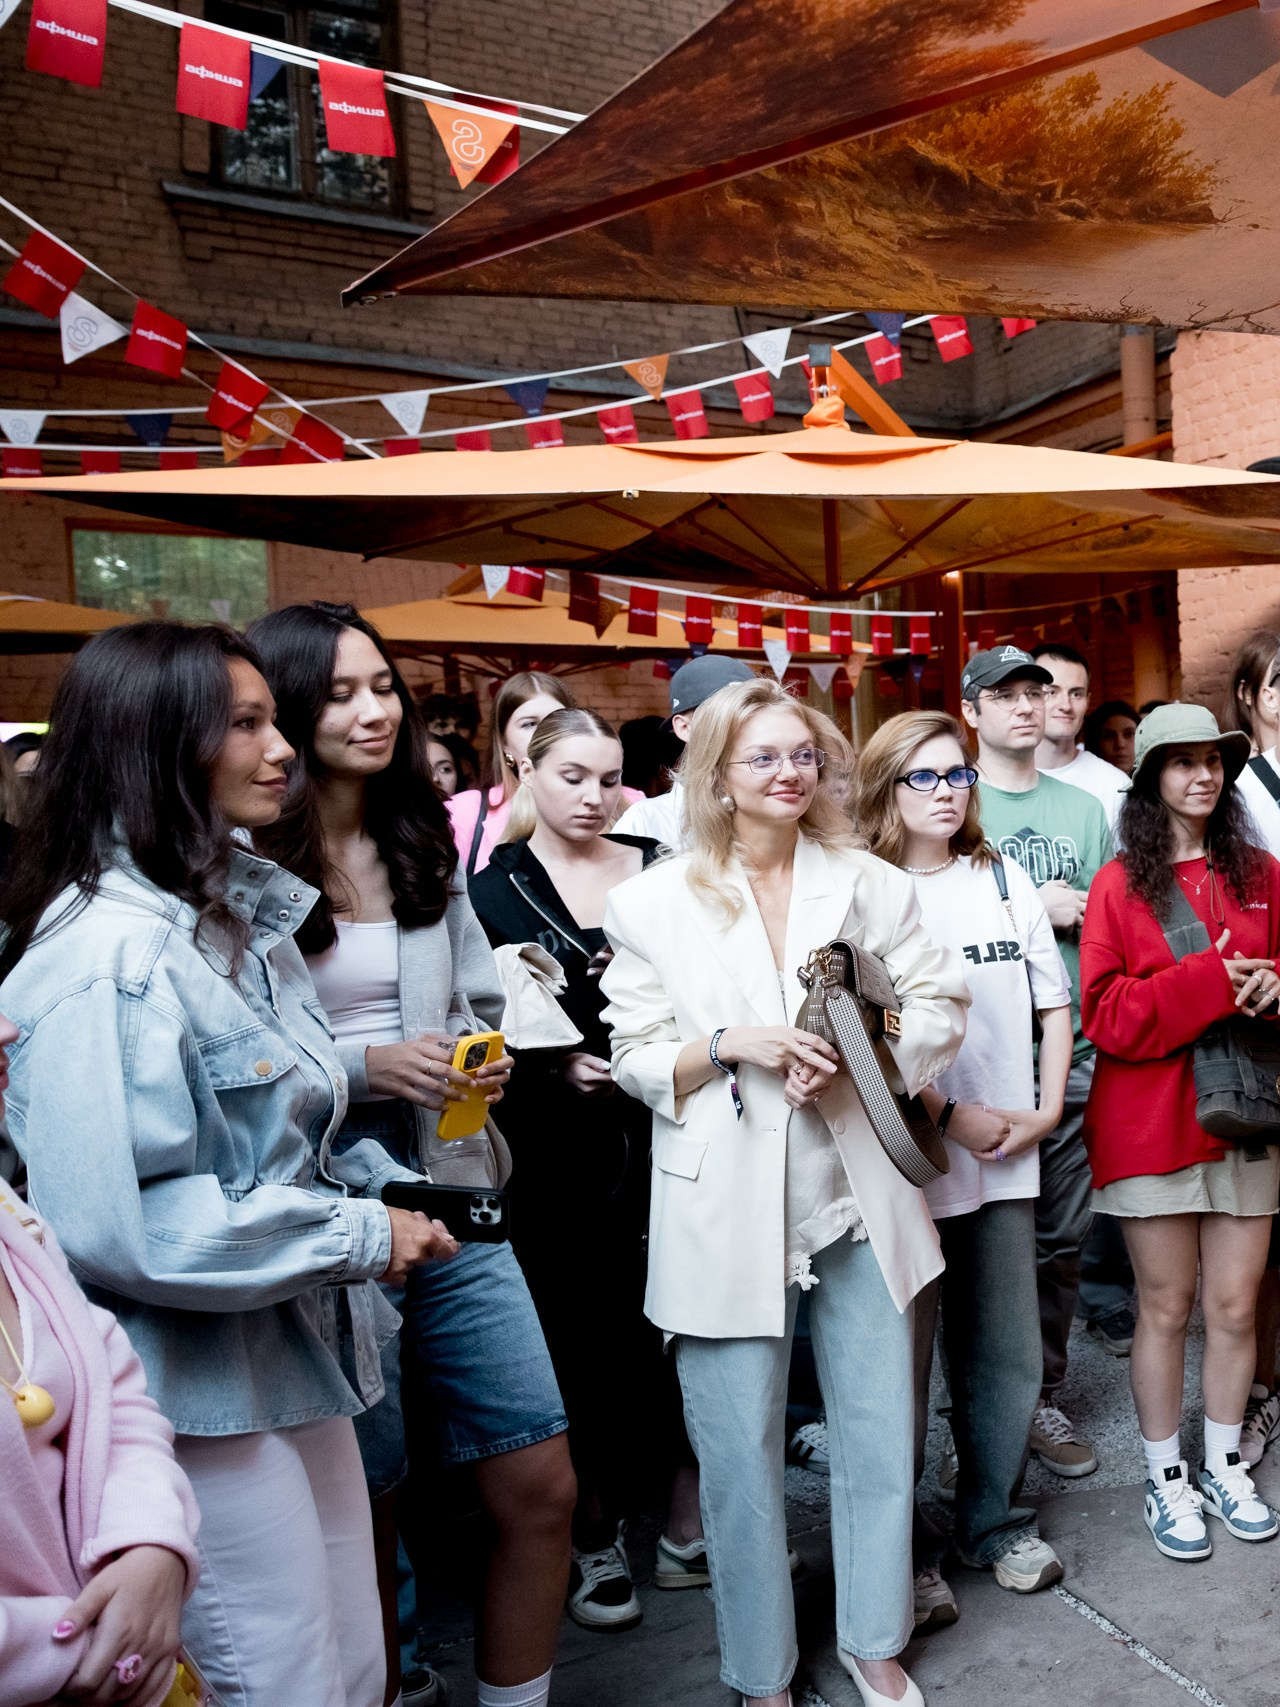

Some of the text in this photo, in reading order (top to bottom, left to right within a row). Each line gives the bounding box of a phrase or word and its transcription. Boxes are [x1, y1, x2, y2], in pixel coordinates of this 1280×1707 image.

[35, 19, 98, 46] афиша
[184, 63, 243, 88] афиша
[328, 101, 385, 118] афиша
